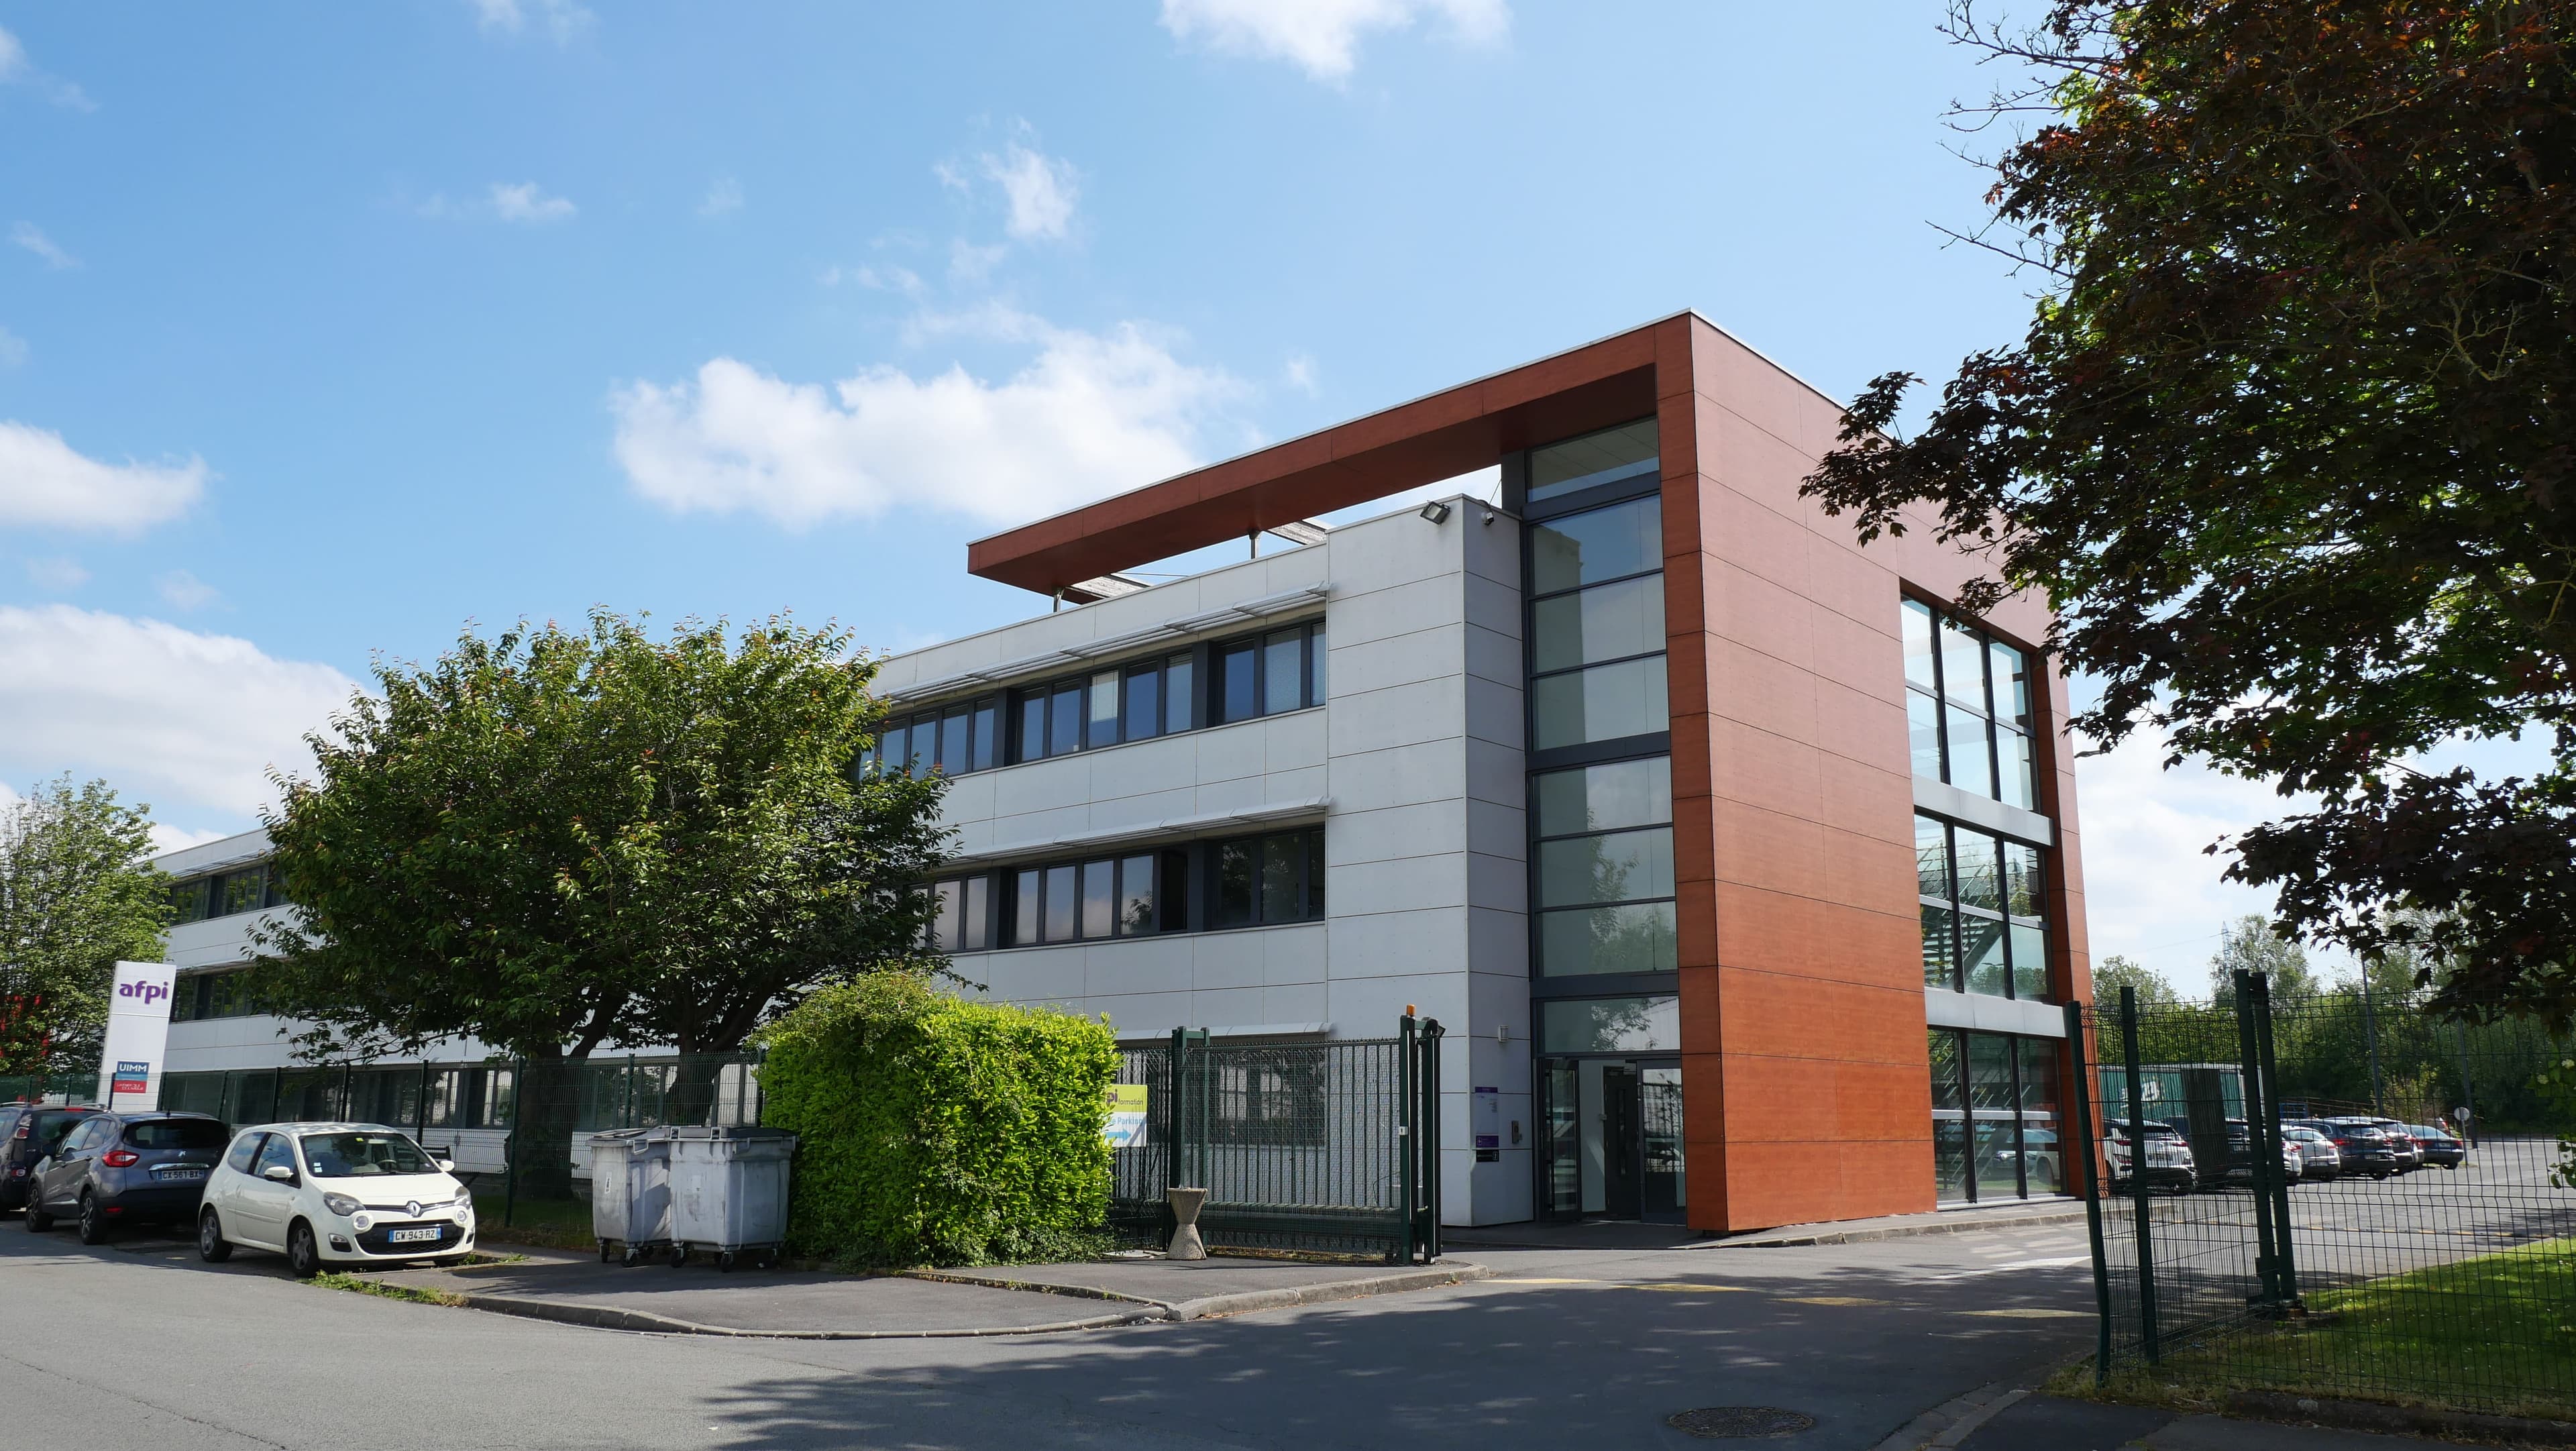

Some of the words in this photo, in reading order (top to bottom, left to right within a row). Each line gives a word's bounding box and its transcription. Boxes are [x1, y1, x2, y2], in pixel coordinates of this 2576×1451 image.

[119, 980, 168, 1004] afpi
[119, 1063, 147, 1072] UIMM
[1106, 1088, 1118, 1106] pi
